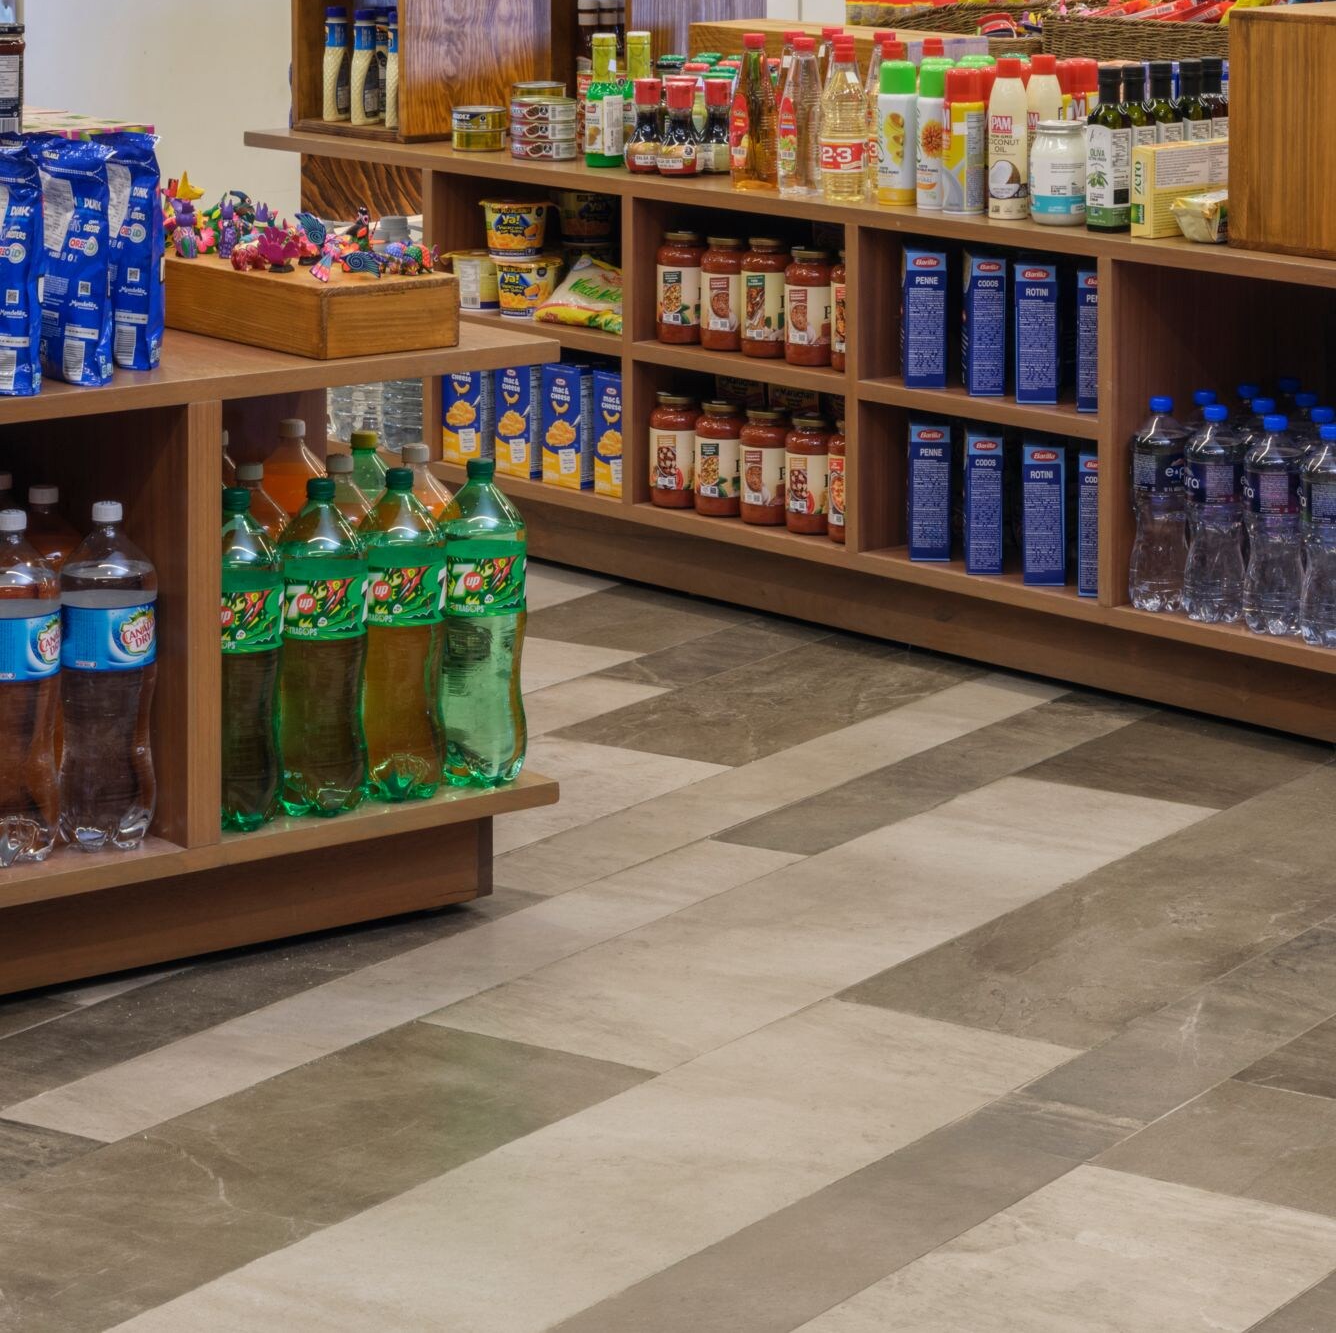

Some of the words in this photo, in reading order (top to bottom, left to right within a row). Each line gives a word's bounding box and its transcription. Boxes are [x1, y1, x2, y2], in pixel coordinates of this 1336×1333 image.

[991, 116, 1012, 132] PAM
[1090, 147, 1105, 157] OLIVA
[914, 258, 938, 267] Barilla
[979, 263, 1000, 271] Barilla
[1024, 270, 1048, 279] Barilla
[915, 276, 939, 285] PENNE
[977, 279, 999, 288] CODOS
[1025, 288, 1049, 297] ROTINI
[919, 431, 942, 440] Barilla
[975, 442, 996, 450] Barilla
[919, 448, 943, 457] PENNE
[1033, 452, 1057, 461] Barilla
[975, 458, 996, 467] CODOS
[1030, 470, 1053, 479] ROTINI
[135, 633, 152, 649] DRY
